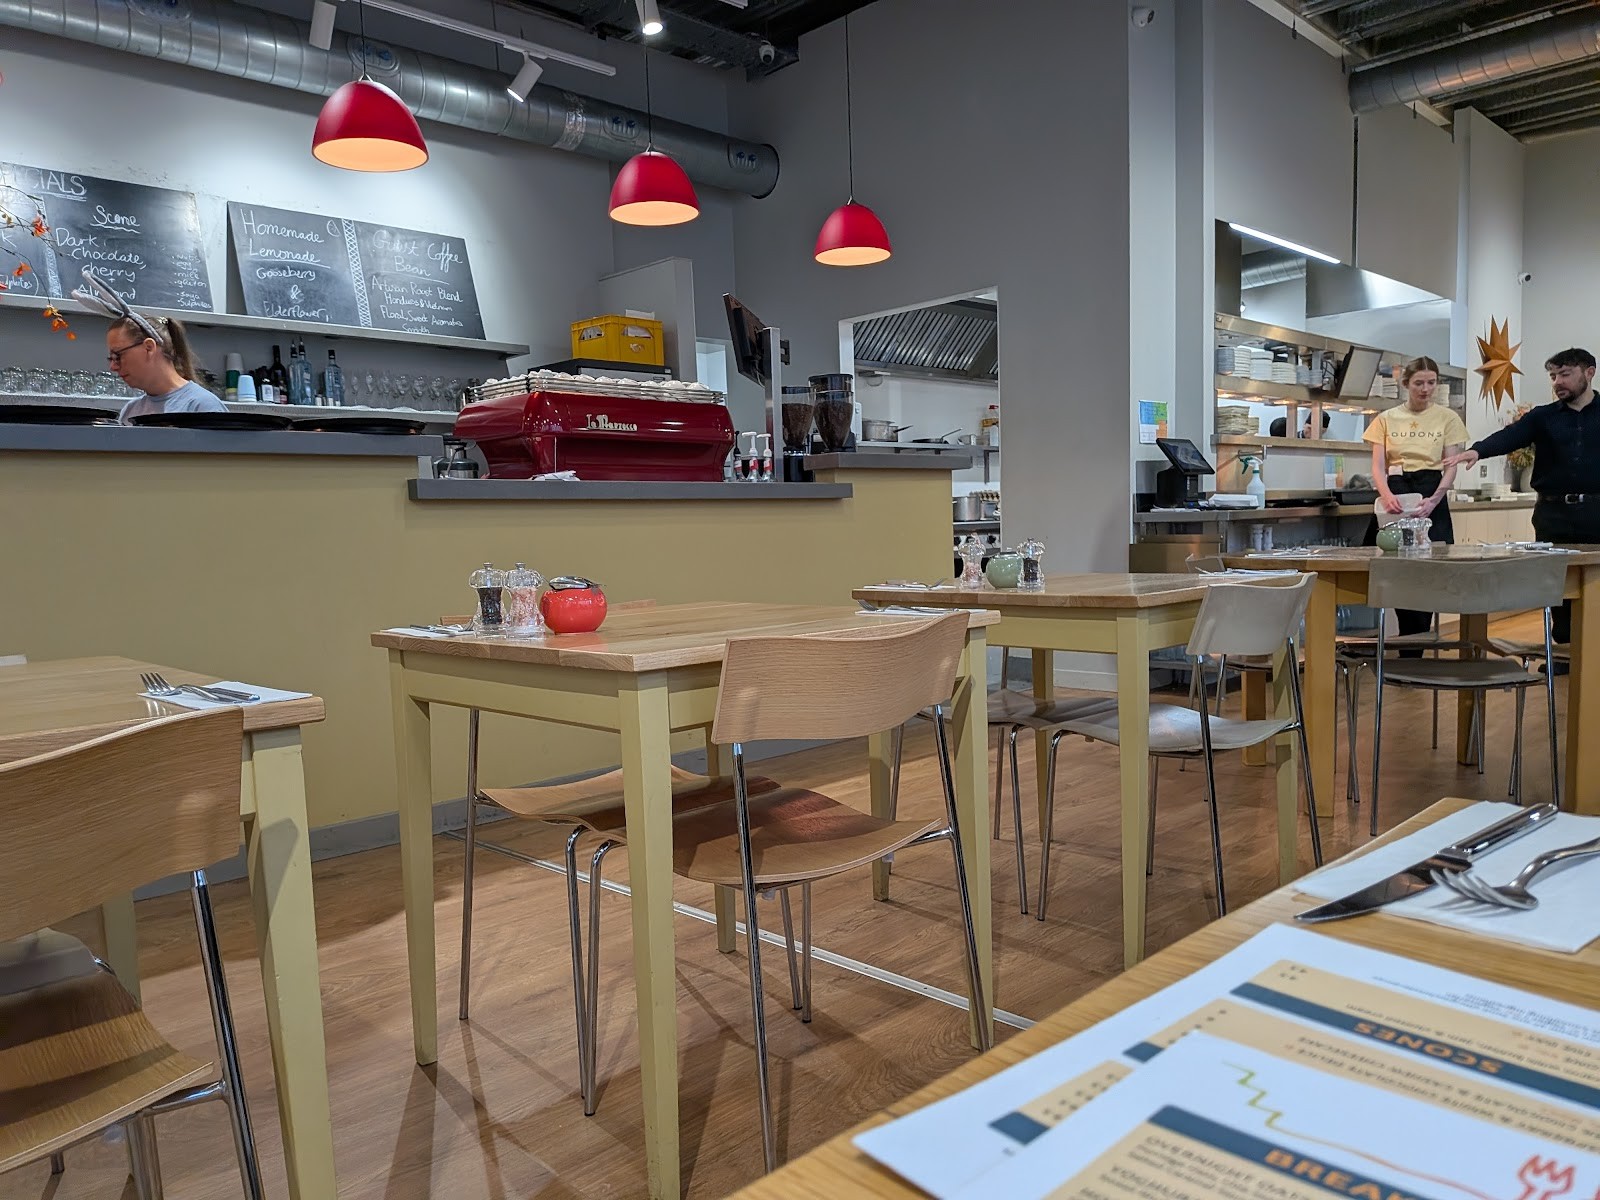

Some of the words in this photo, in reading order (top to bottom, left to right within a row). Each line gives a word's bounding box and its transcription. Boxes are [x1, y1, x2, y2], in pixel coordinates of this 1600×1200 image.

[240, 208, 324, 243] Homemade
[249, 238, 320, 262] Lemonade
[427, 242, 463, 273] Coffee
[256, 265, 316, 281] Gooseberry
[394, 255, 431, 277] Bean
[290, 284, 303, 301] &
[372, 275, 407, 293] Artisan
[410, 281, 433, 298] Roast
[437, 287, 464, 303] Blend
[1354, 1022, 1503, 1074] SCONES
